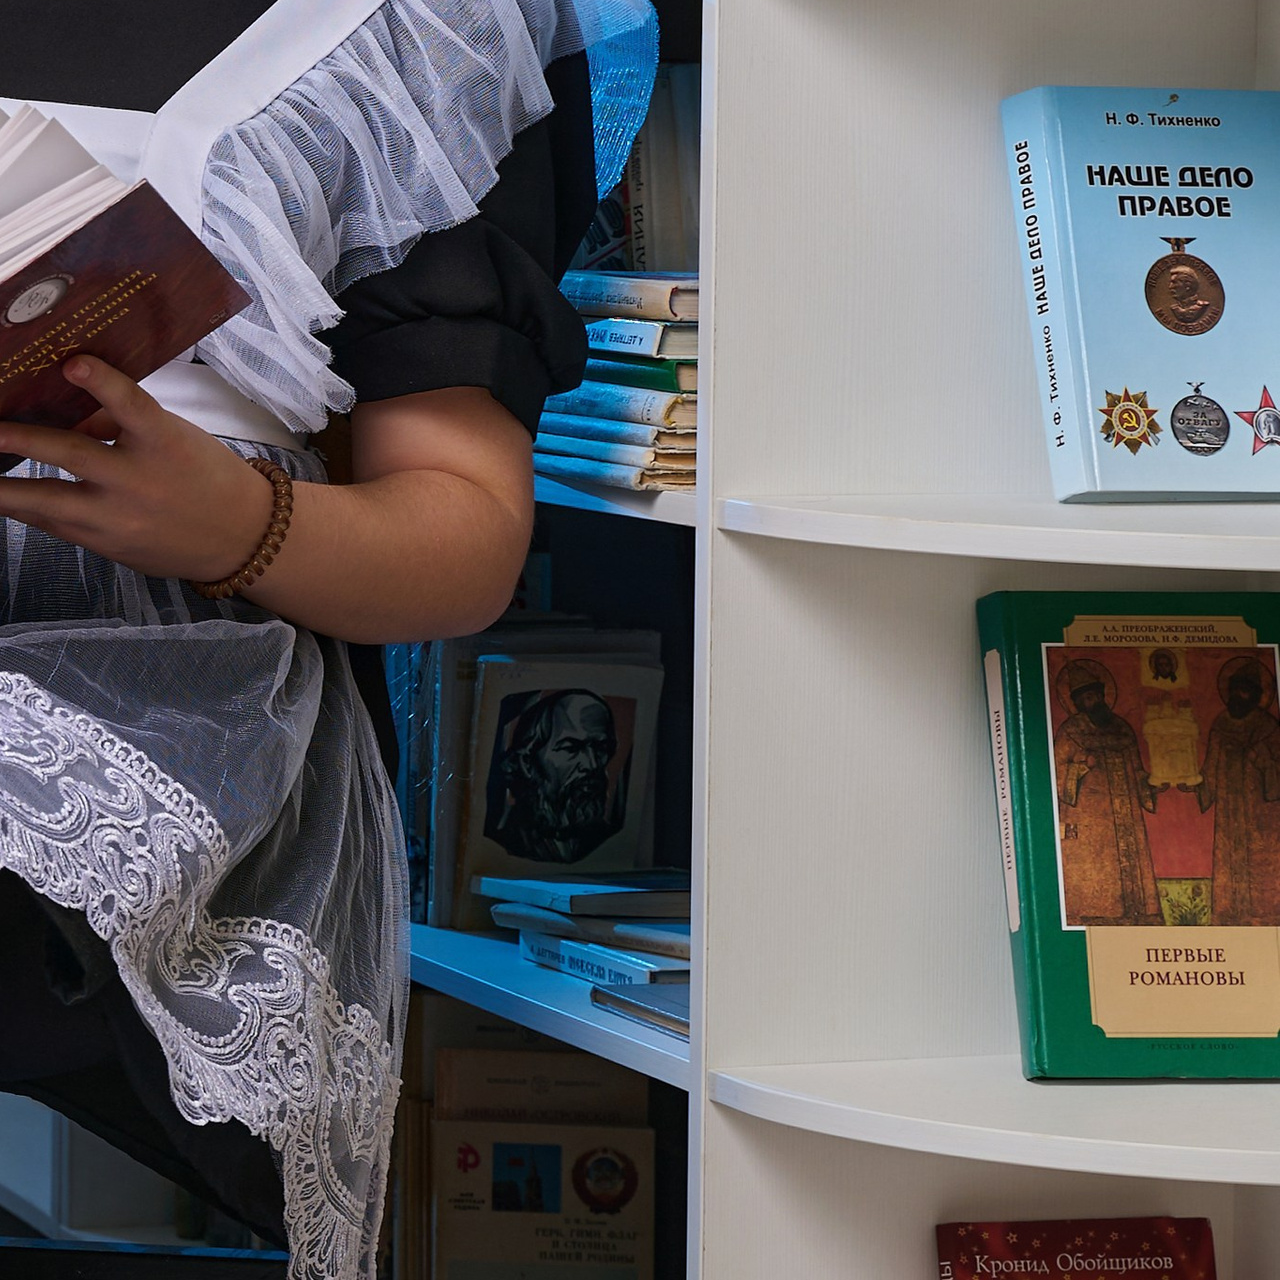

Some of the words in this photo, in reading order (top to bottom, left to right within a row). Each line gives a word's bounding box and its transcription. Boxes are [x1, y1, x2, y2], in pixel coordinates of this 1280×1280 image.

[1106, 112, 1122, 126] Н.
[1126, 112, 1144, 126] Ф.
[1148, 113, 1221, 128] Тихненко
[1014, 140, 1038, 211] ПРАВОЕ
[1086, 165, 1170, 187] НАШЕ
[1178, 166, 1254, 189] ДЕЛО
[1118, 195, 1232, 218] ПРАВОЕ
[1024, 214, 1043, 261] ДЕЛО
[71, 269, 142, 320] поэзия
[1029, 264, 1051, 316] НАШЕ
[58, 272, 159, 342] половины
[29, 339, 81, 378] XIX
[85, 306, 131, 340] века
[1044, 325, 1059, 404] Тихненко
[1052, 405, 1062, 425] Ф.
[1178, 418, 1222, 427] ОТВАГУ
[1193, 411, 1207, 419] ЗА
[1055, 433, 1065, 448] Н.
[1083, 634, 1101, 643] Л.Е.
[1162, 634, 1182, 644] Н.Ф.
[1184, 634, 1238, 644] ДЕМИДОВА
[1102, 624, 1119, 634] А.А.
[993, 709, 1008, 802] РОМАНОВЫ
[1003, 806, 1014, 871] ПЕРВЫЕ
[1145, 948, 1226, 964] ПЕРВЫЕ
[1129, 971, 1246, 986] РОМАНОВЫ
[1150, 1042, 1197, 1051] РУССКОЕ
[975, 1255, 1050, 1277] Кронид
[1056, 1252, 1174, 1275] Обойщиков
